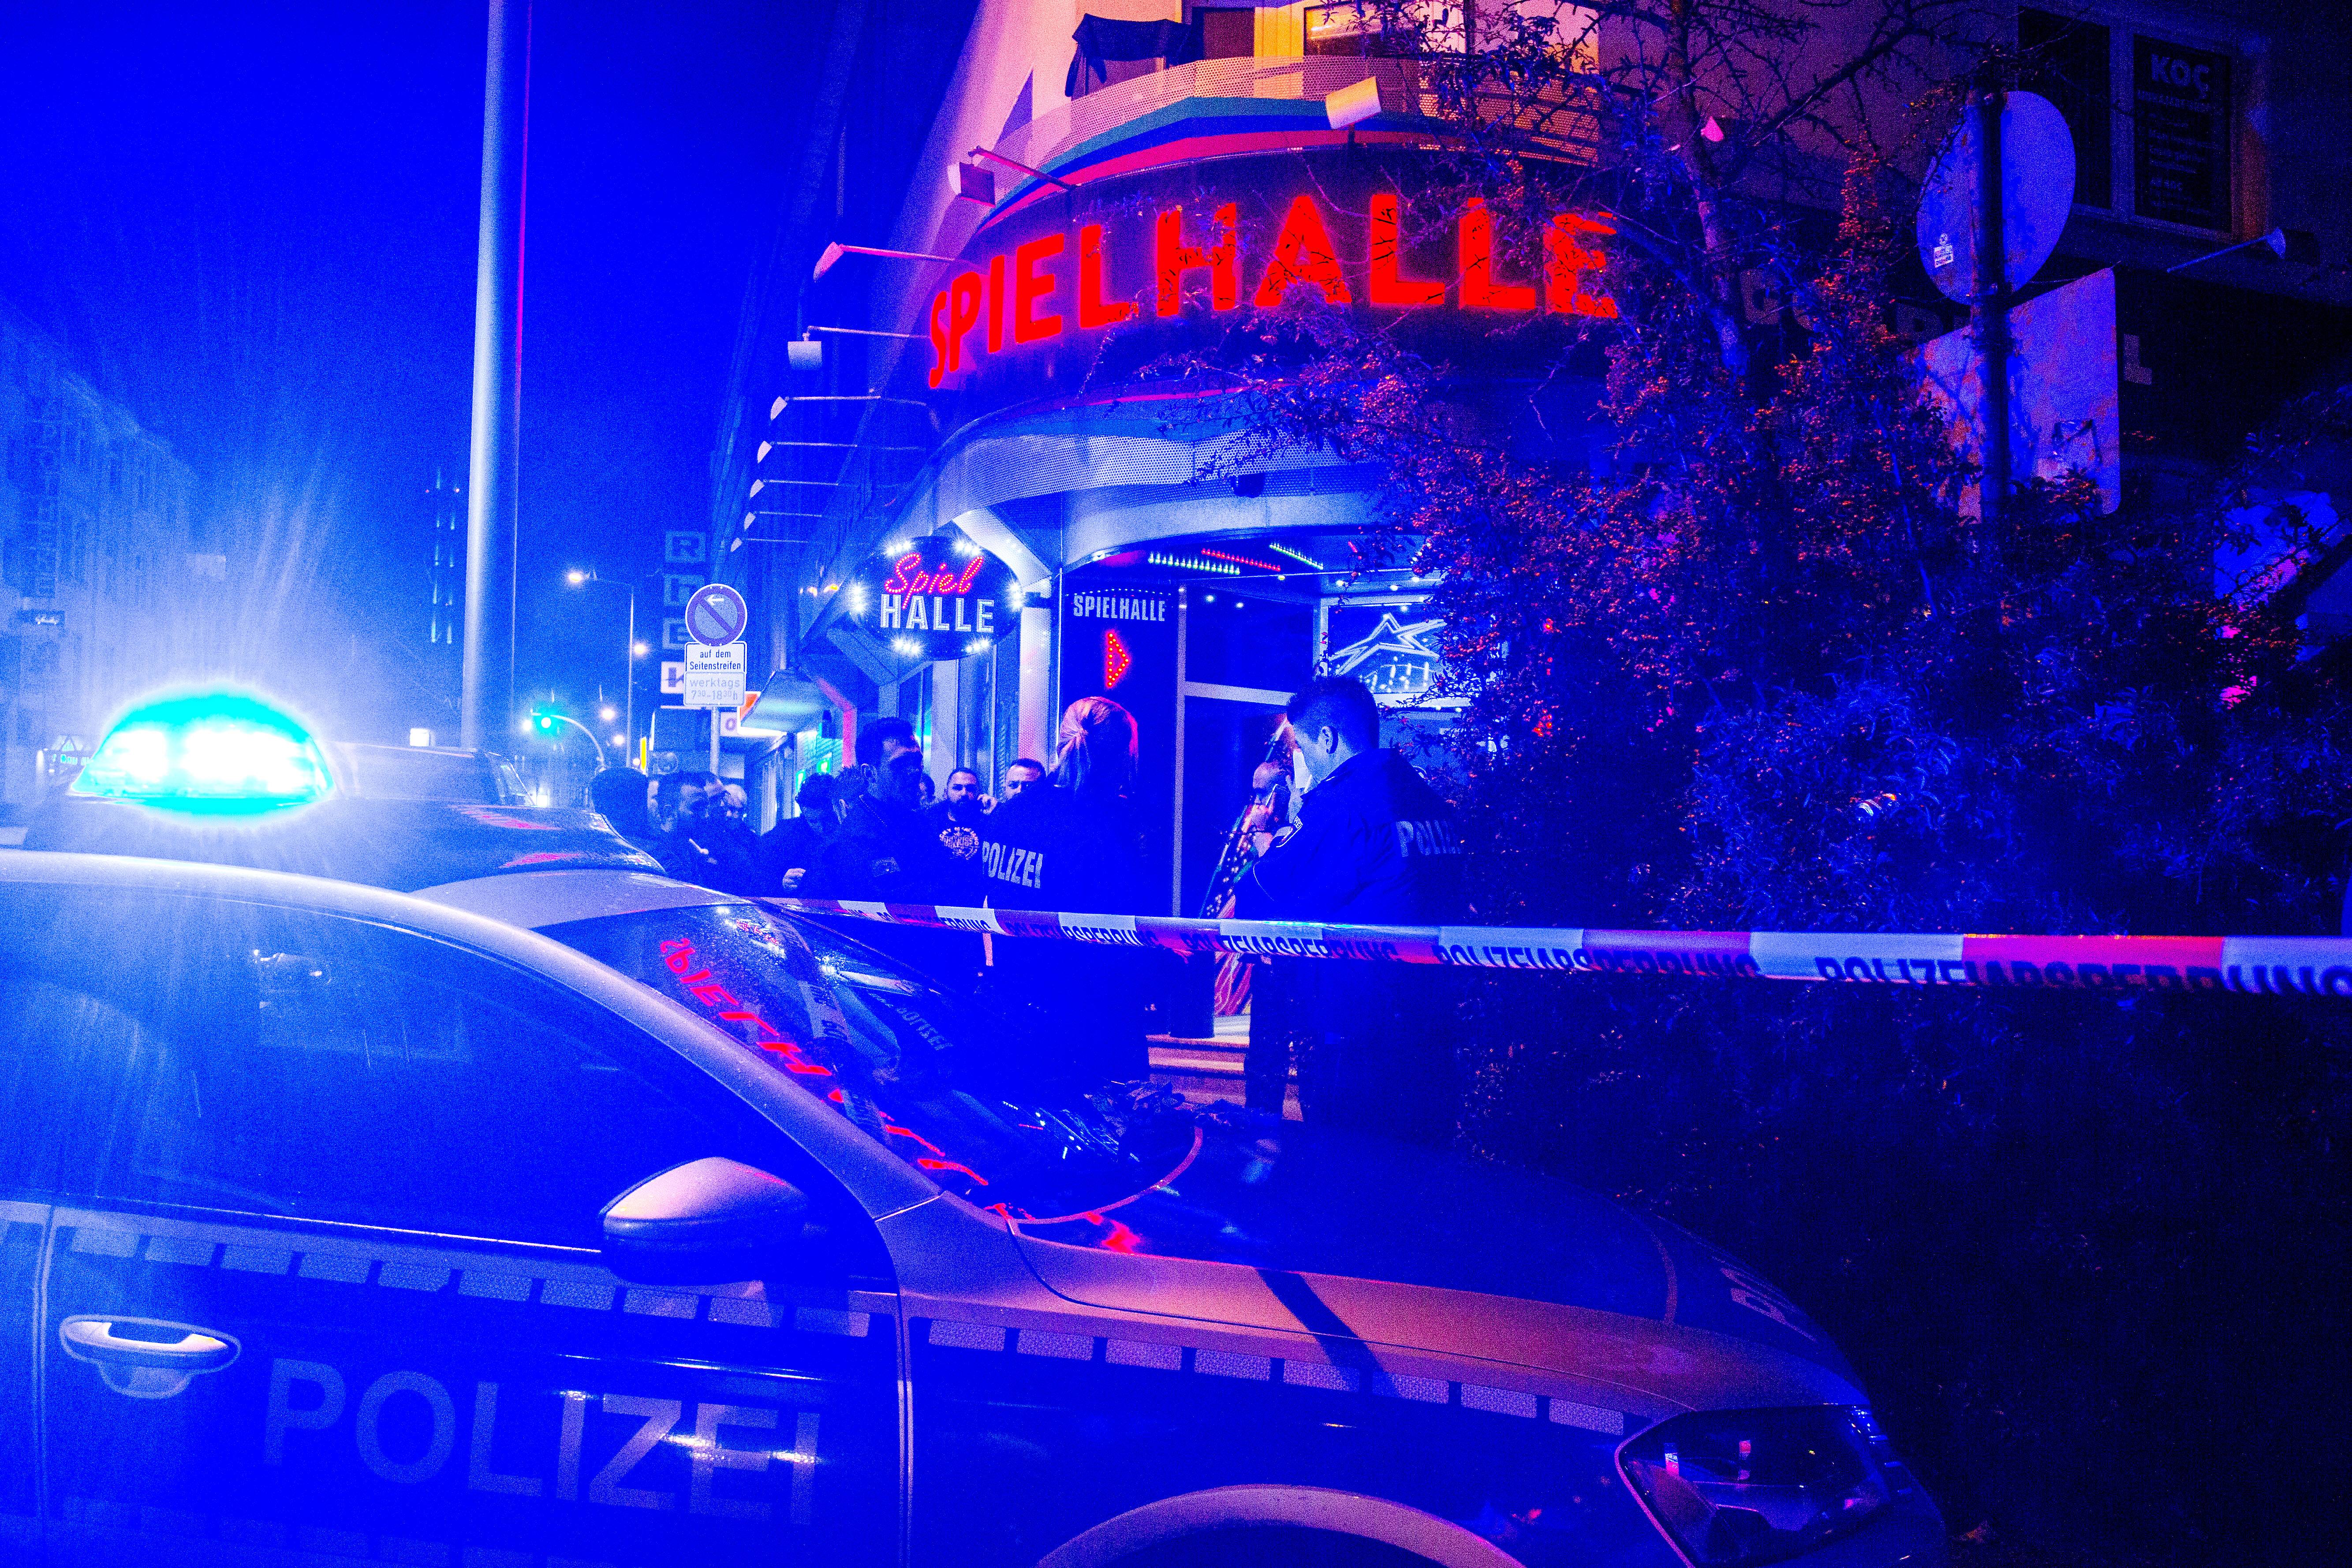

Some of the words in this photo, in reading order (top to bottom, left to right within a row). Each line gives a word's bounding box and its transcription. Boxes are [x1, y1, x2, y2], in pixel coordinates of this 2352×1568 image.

[929, 194, 1618, 388] SPIELHALLE
[885, 553, 983, 609] Spiel
[880, 594, 994, 633] HALLE
[1073, 594, 1165, 622] SPIELHALLE
[690, 661, 741, 670] Seitenstreifen
[700, 649, 712, 658] auf
[716, 649, 731, 658] dem
[689, 677, 740, 690] werktags
[982, 840, 1043, 889] POLIZEI
[261, 1357, 821, 1525] POLIZEI
